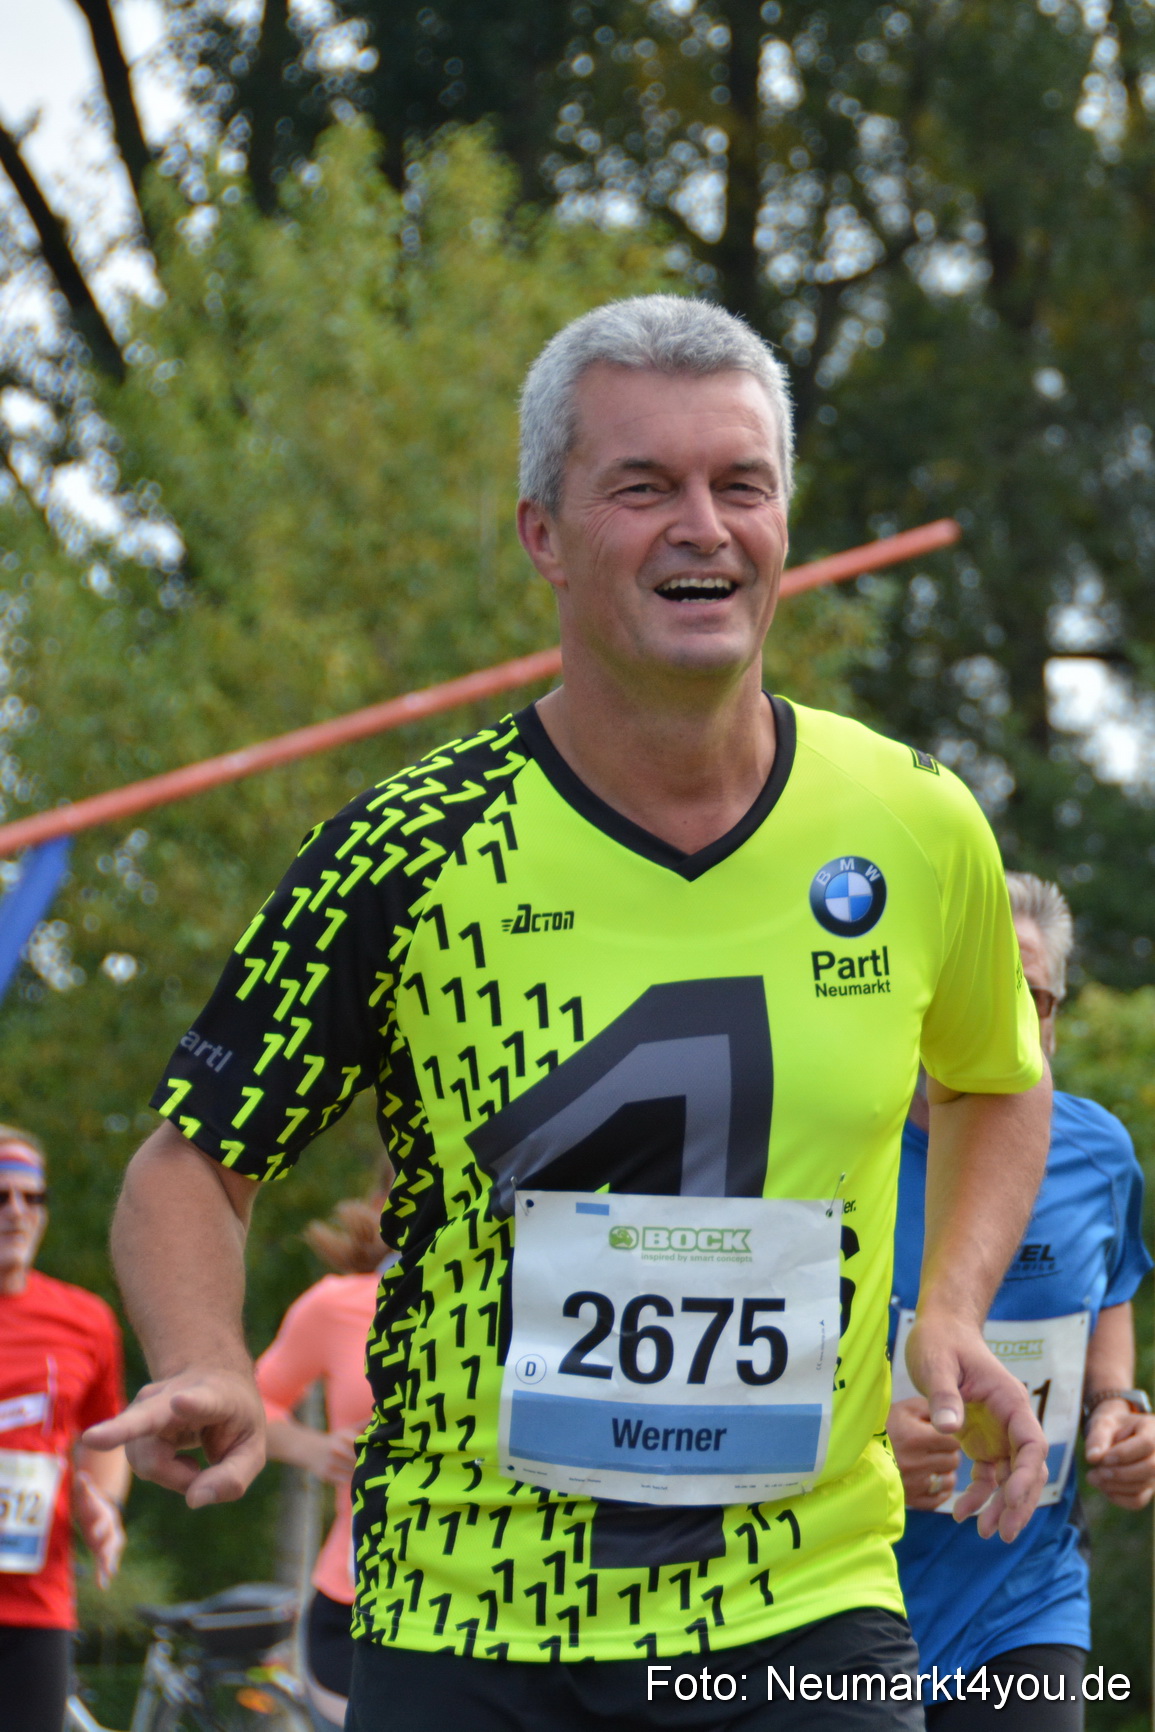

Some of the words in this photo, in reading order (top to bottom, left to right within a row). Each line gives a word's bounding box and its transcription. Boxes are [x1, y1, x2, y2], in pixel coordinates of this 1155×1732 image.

[814, 857, 882, 887] BMW
[510, 903, 575, 935] ACTON
[811, 945, 890, 981] Partl
[815, 978, 891, 998] Neumarkt
[641, 1226, 752, 1254] BOCK
[641, 1252, 675, 1263] inspired
[677, 1254, 688, 1263] by
[690, 1254, 714, 1263] smart
[716, 1255, 753, 1264] concepts
[557, 1290, 789, 1386] 2675
[611, 1417, 728, 1452] Werner
